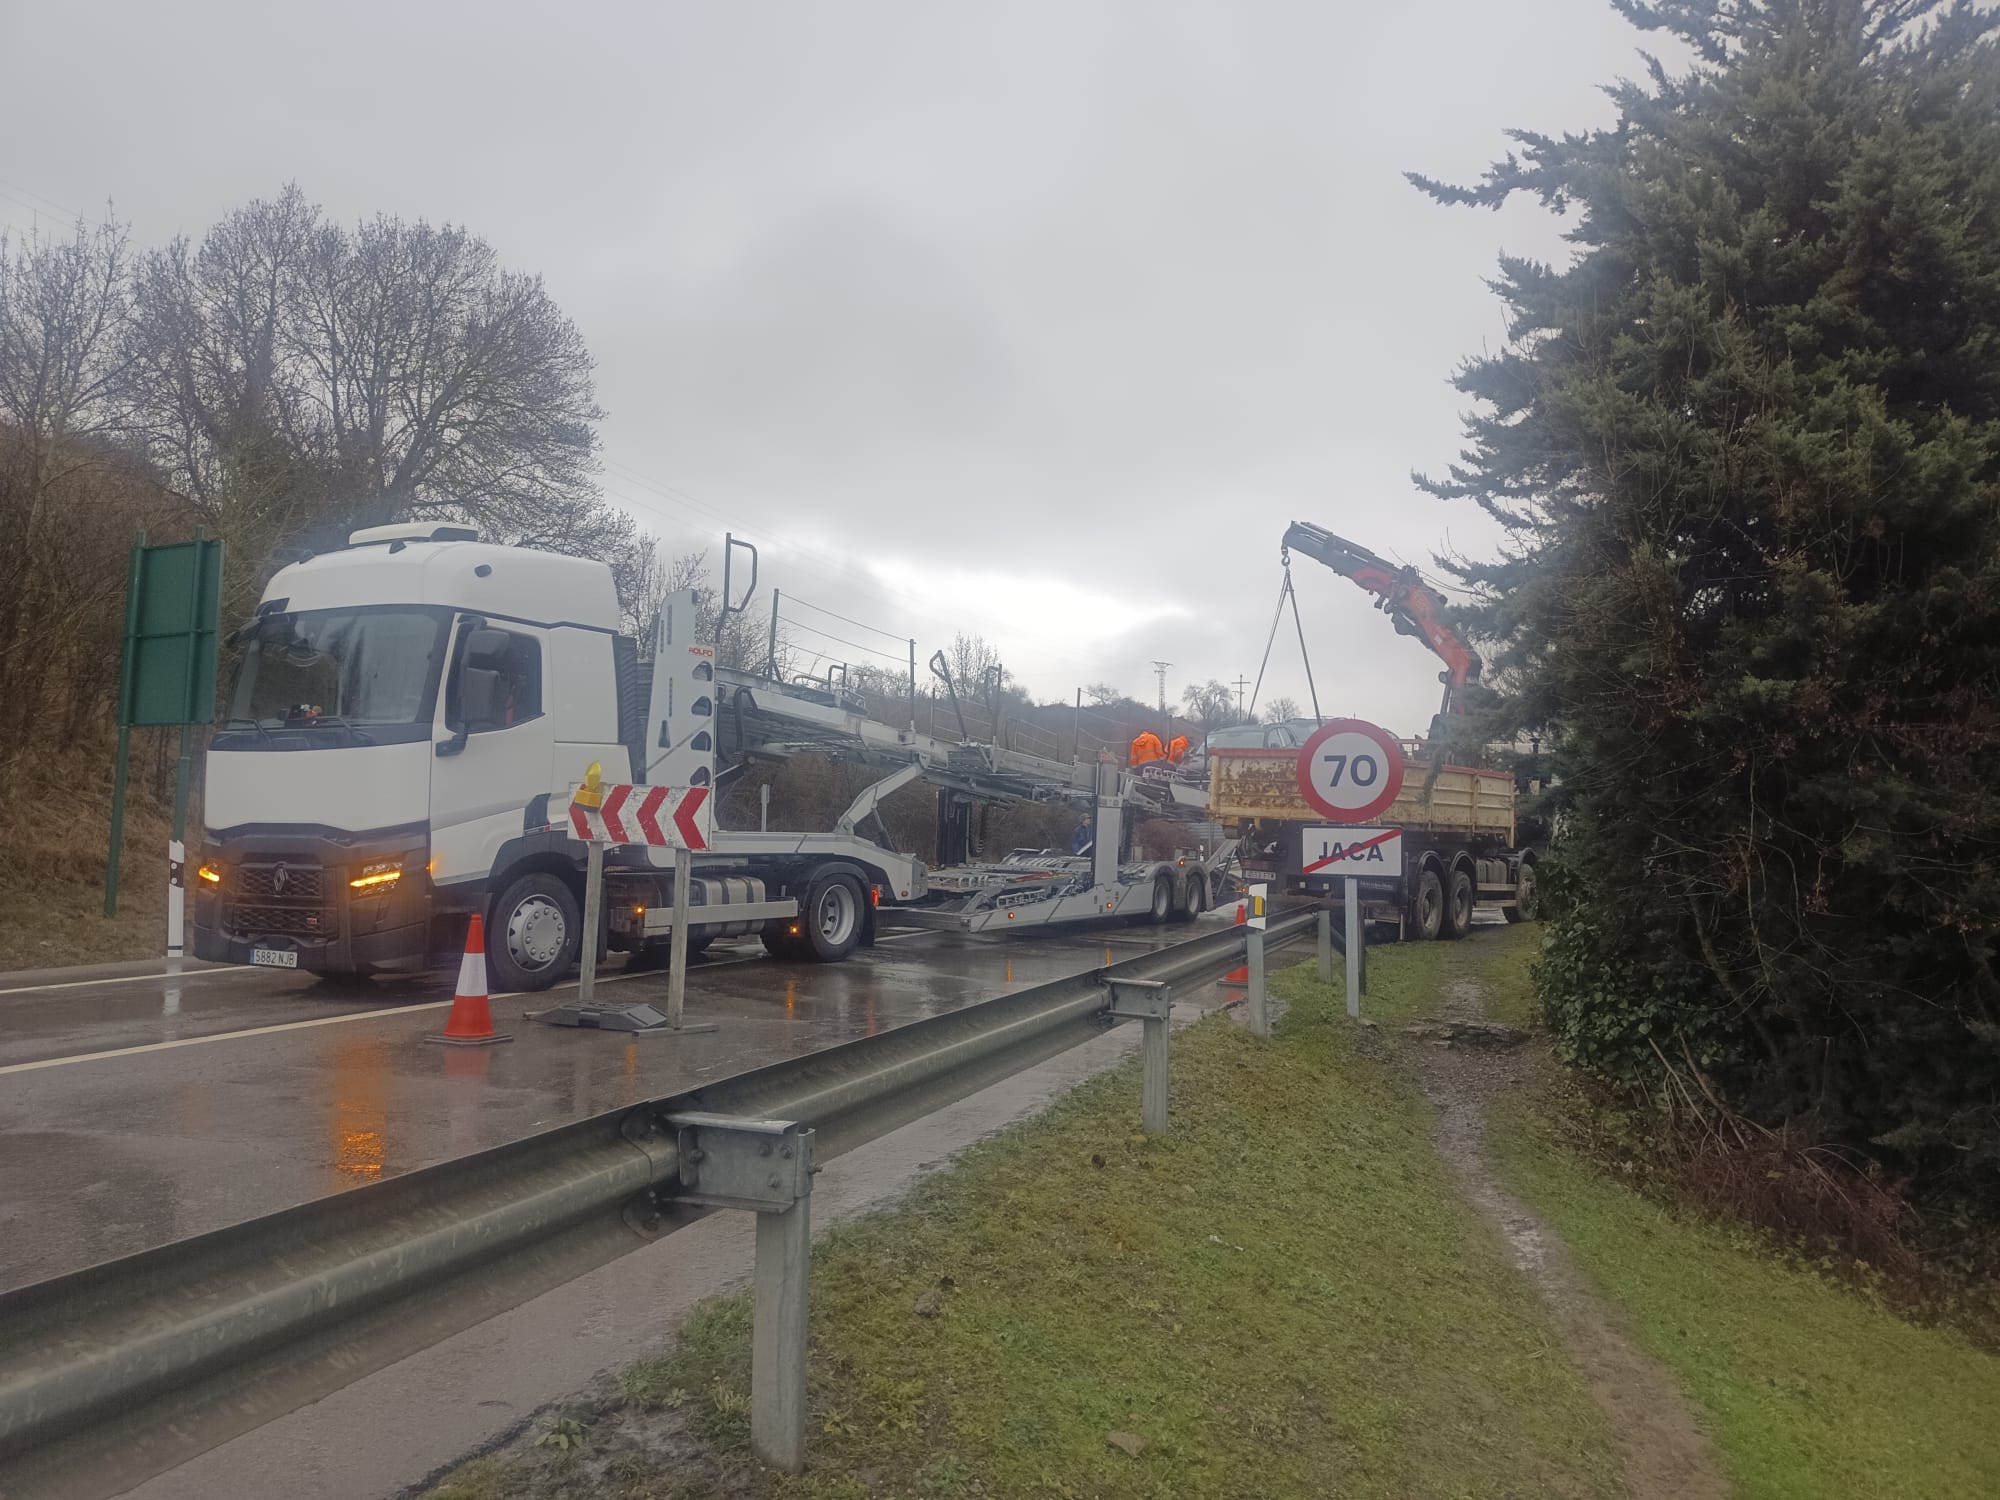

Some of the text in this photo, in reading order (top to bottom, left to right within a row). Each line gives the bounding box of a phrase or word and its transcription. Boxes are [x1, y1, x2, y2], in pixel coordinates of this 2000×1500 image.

[1324, 754, 1378, 788] 70
[1318, 841, 1384, 862] JACA
[255, 950, 295, 966] 5882 NJB
